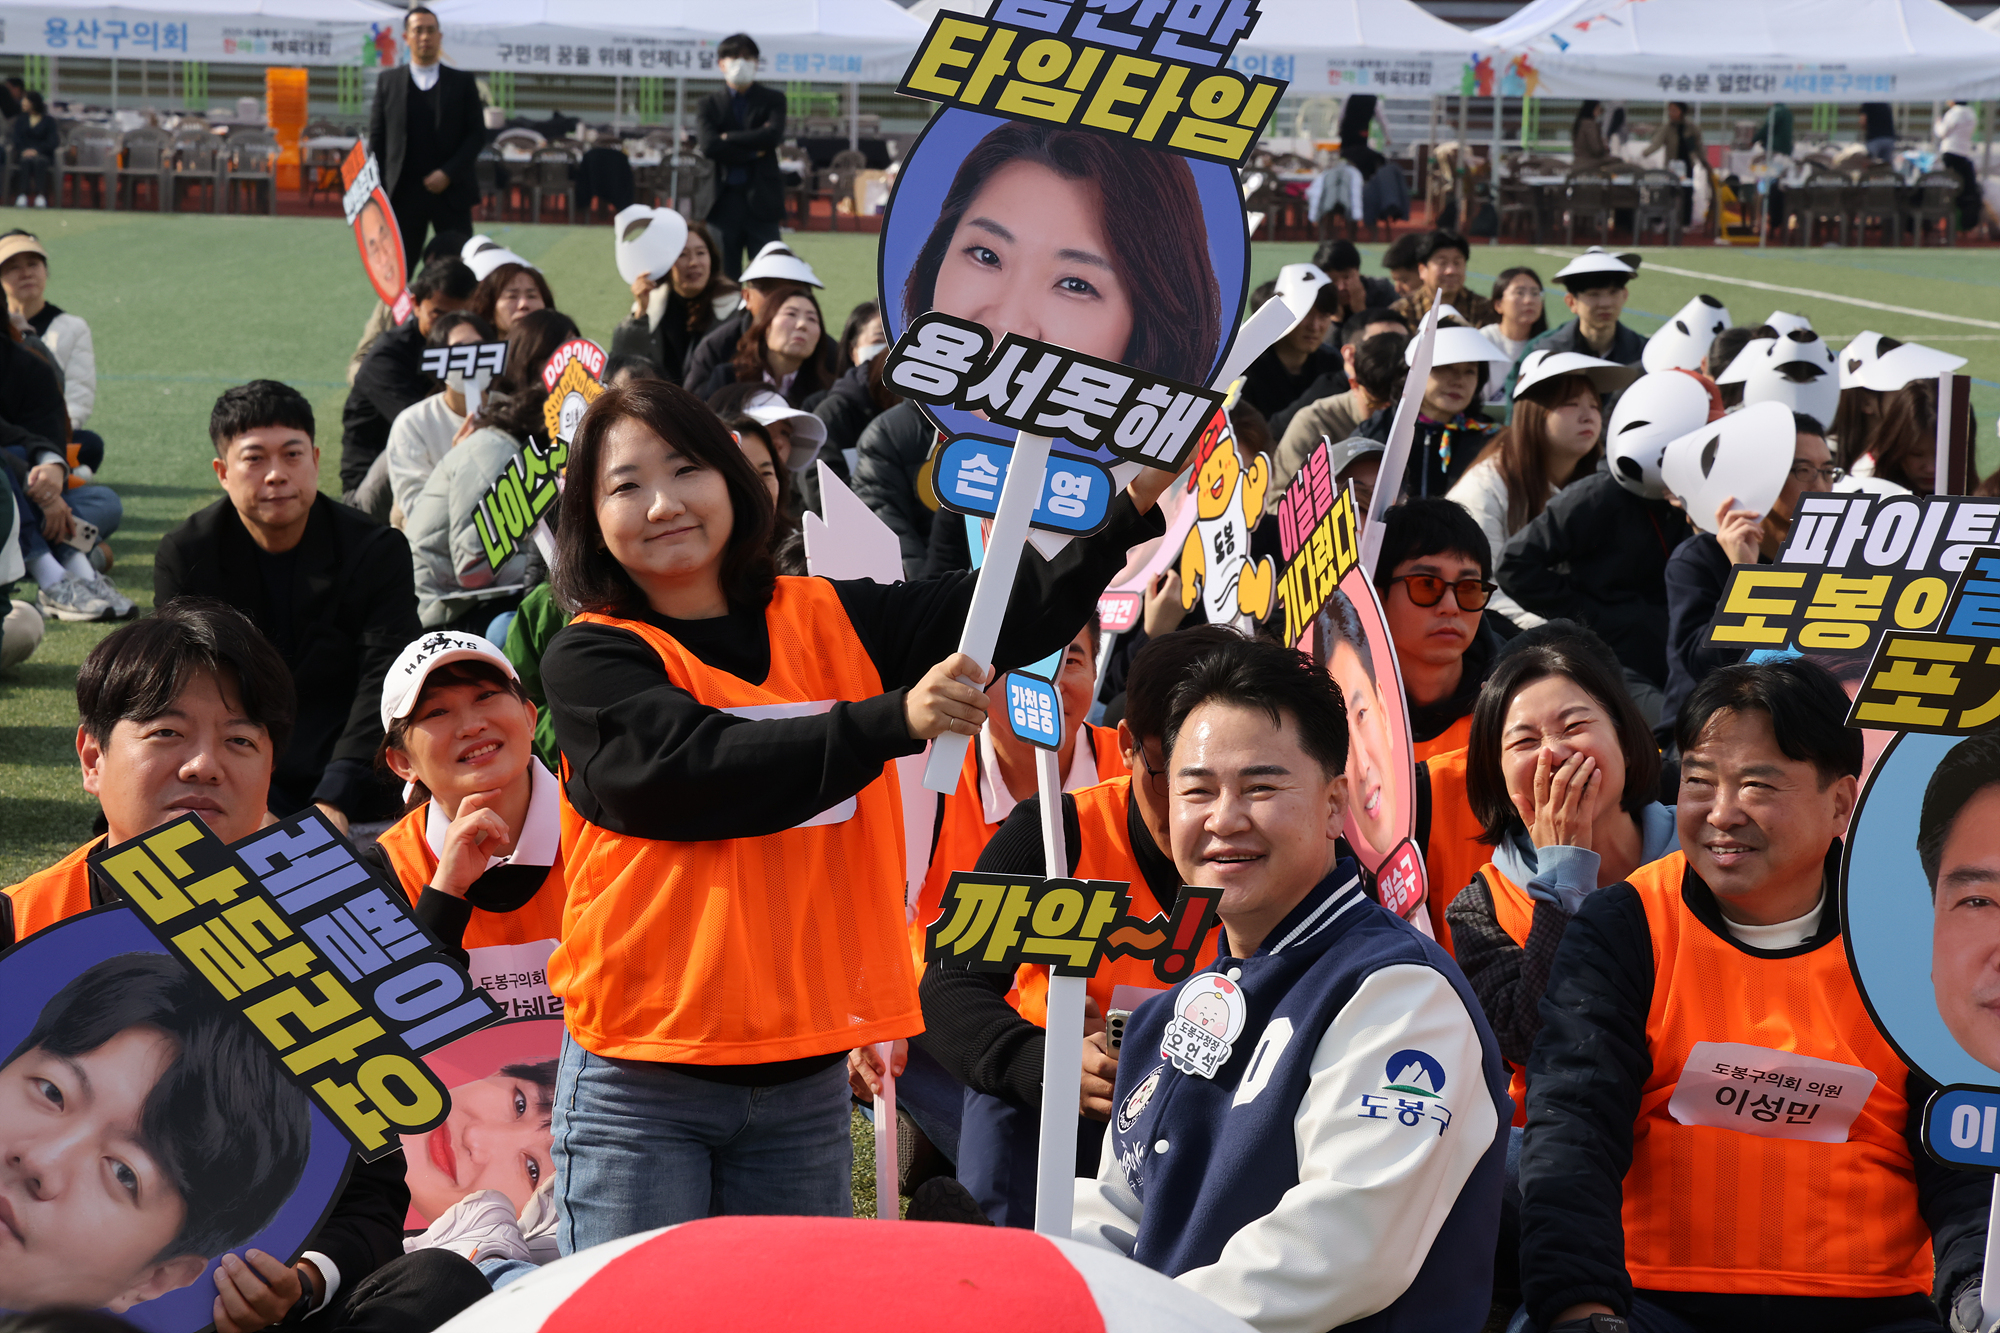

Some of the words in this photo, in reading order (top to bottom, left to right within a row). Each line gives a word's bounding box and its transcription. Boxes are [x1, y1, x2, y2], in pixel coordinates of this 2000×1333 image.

[44, 17, 187, 52] 용산구의회
[557, 45, 591, 67] 꿈을
[598, 46, 633, 67] 위해
[638, 48, 691, 69] 언제나
[906, 17, 1278, 160] 타임타임
[421, 342, 506, 379] ㅋㅋㅋ
[892, 322, 1212, 463] 용서못해
[955, 452, 1092, 519] 손영
[1278, 442, 1333, 562] 이날을
[1214, 521, 1236, 565] 도봉
[1277, 488, 1358, 648] 기다렸다
[404, 638, 478, 675] HAZZYS
[1011, 684, 1054, 735] 강철웅
[1380, 853, 1416, 913] 정승구
[235, 815, 494, 1051] 레벨이
[100, 820, 443, 1151] 남달라요
[480, 968, 547, 991] 도봉구의회
[1179, 1021, 1220, 1052] 도봉구청장
[1712, 1062, 1802, 1092] 도봉구의회
[1805, 1081, 1843, 1099] 의원
[1357, 1094, 1453, 1137] 도봉구
[1715, 1086, 1821, 1125] 이성민
